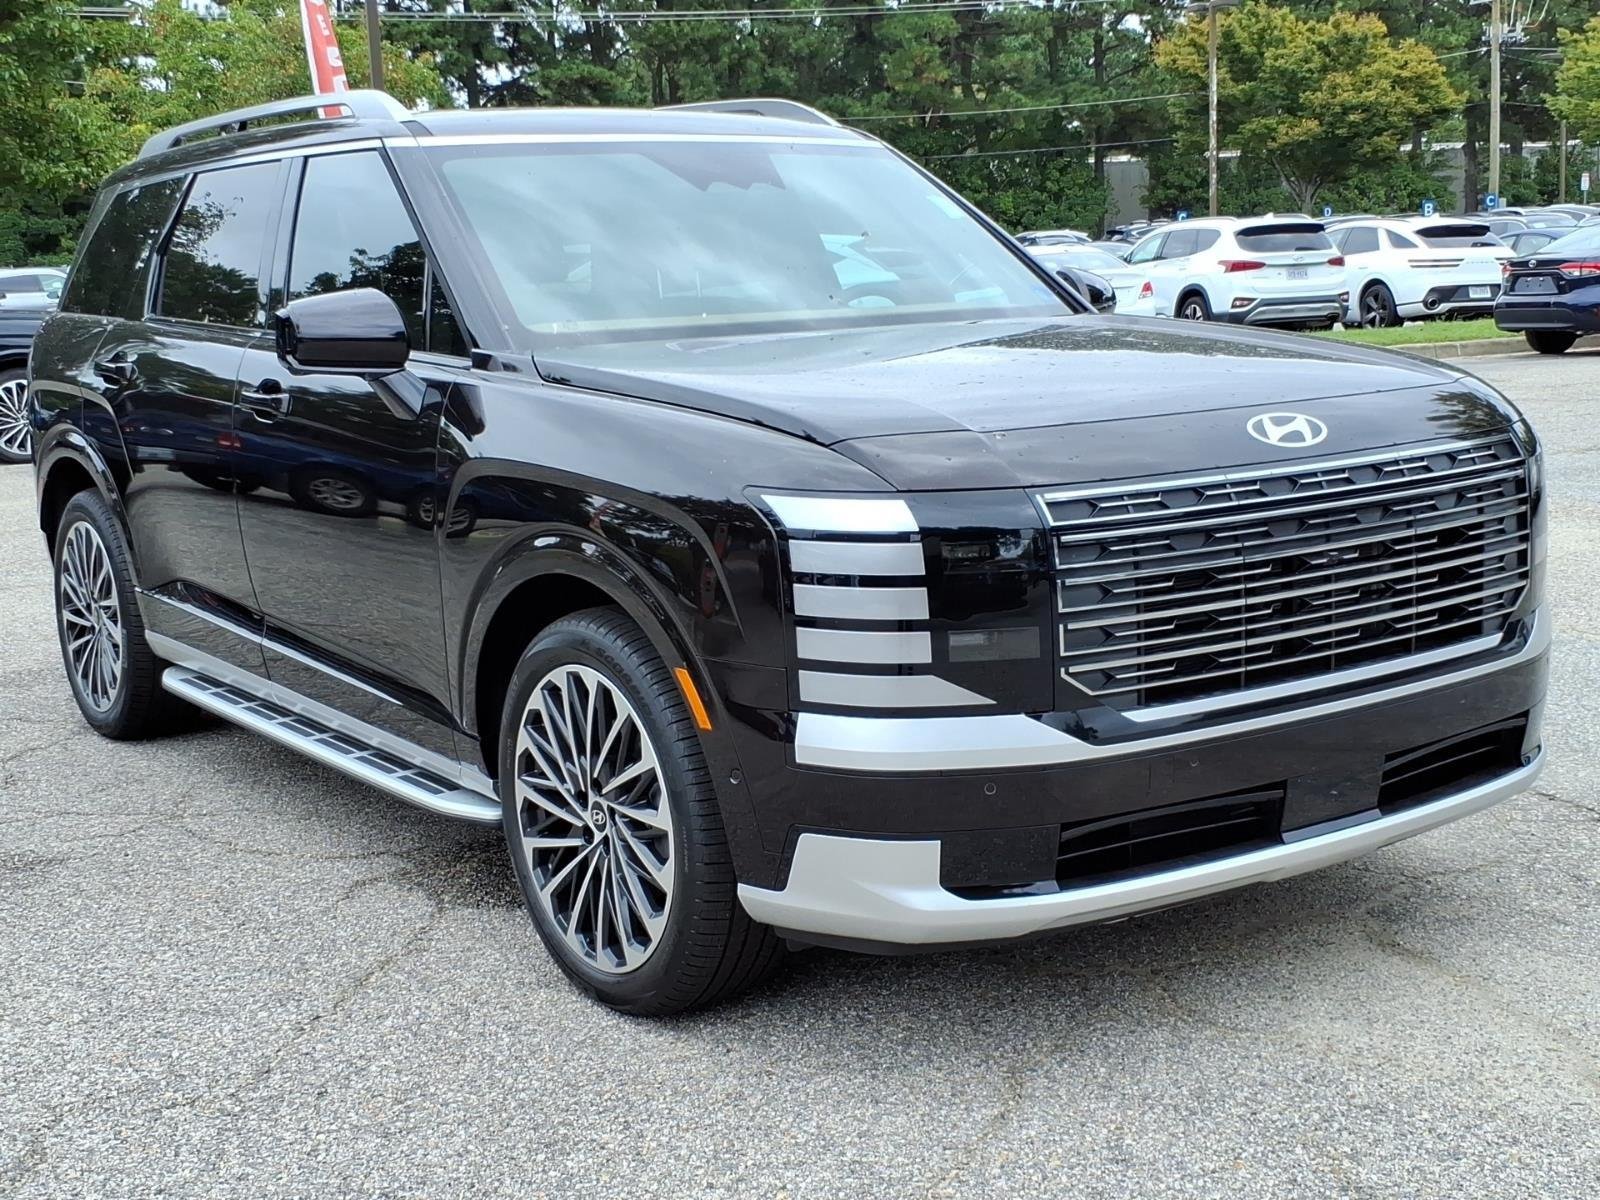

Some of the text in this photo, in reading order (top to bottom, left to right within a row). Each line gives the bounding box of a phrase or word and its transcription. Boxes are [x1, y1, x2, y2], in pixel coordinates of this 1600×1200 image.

[1486, 195, 1495, 207] C
[1324, 207, 1332, 217] D
[1424, 203, 1433, 217] B
